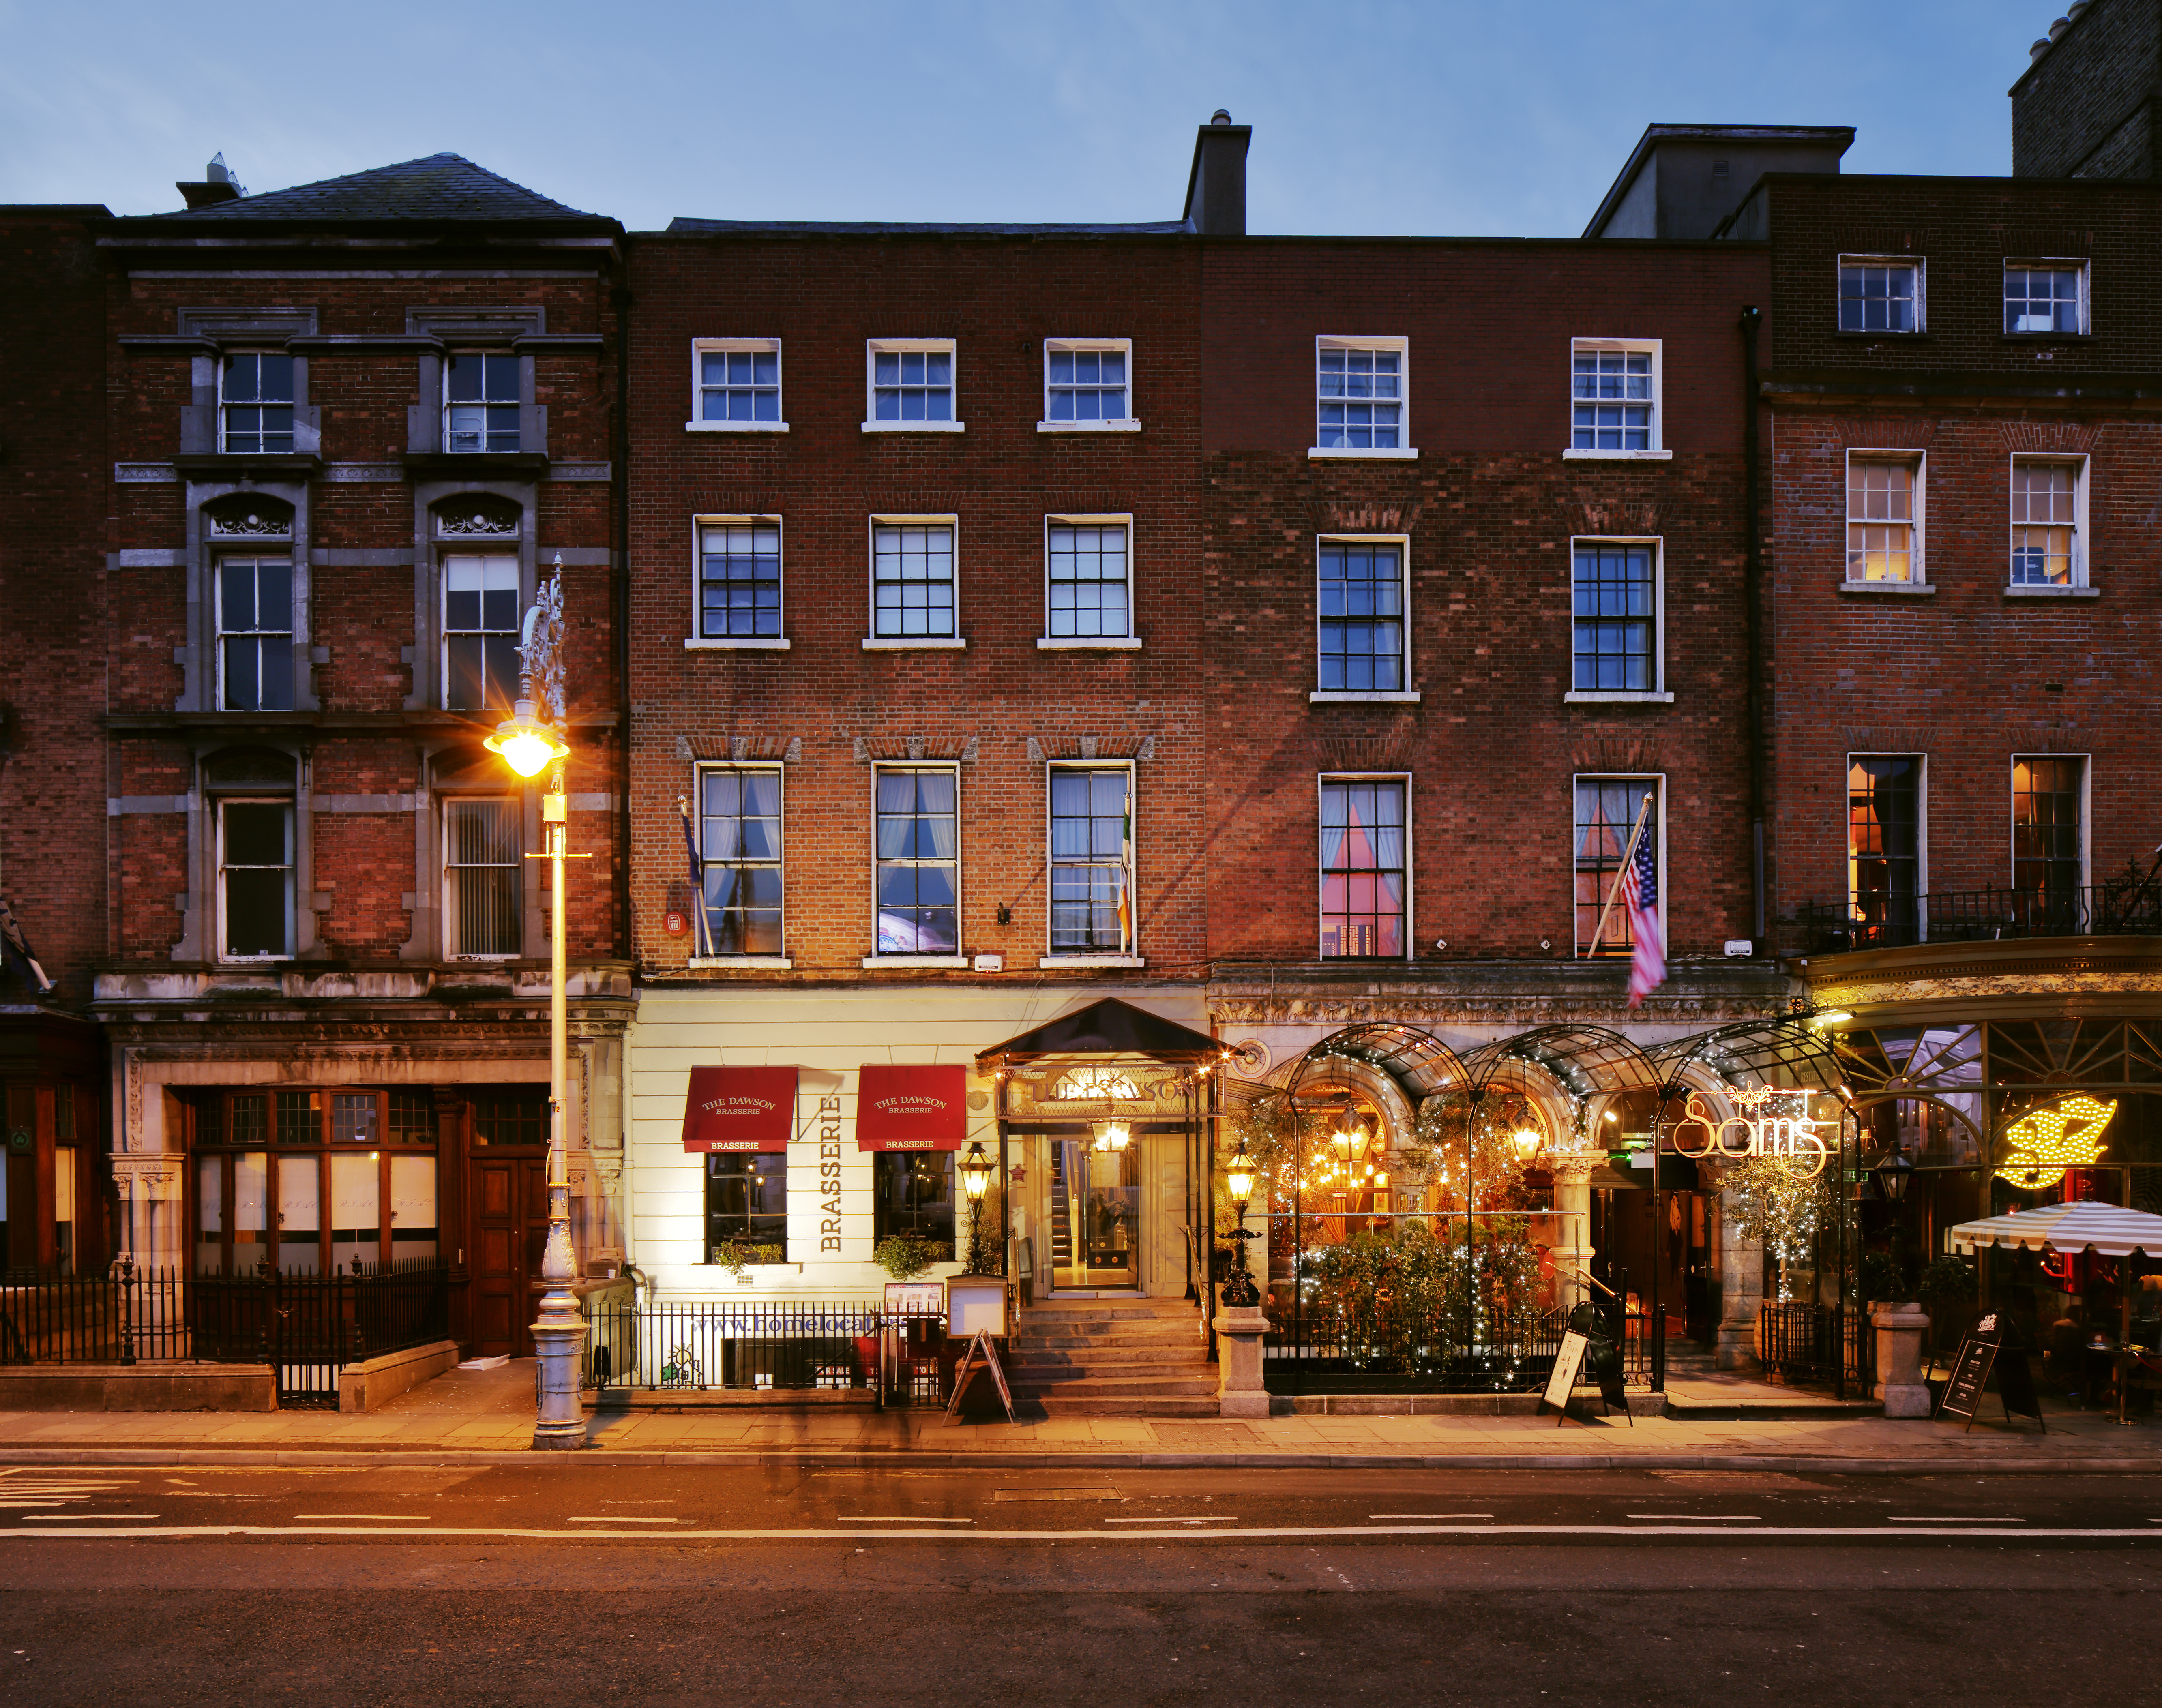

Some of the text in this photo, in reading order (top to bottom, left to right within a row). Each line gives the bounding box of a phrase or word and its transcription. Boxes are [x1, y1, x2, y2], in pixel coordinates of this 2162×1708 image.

[1801, 1069, 1828, 1082] RESTAURNT
[1085, 1081, 1195, 1101] DWSON
[702, 1097, 776, 1110] THE DAWSON
[874, 1096, 947, 1109] THE DAWSON
[821, 1097, 841, 1252] BRASSERIE
[692, 1315, 908, 1331] www.homelocatrs
